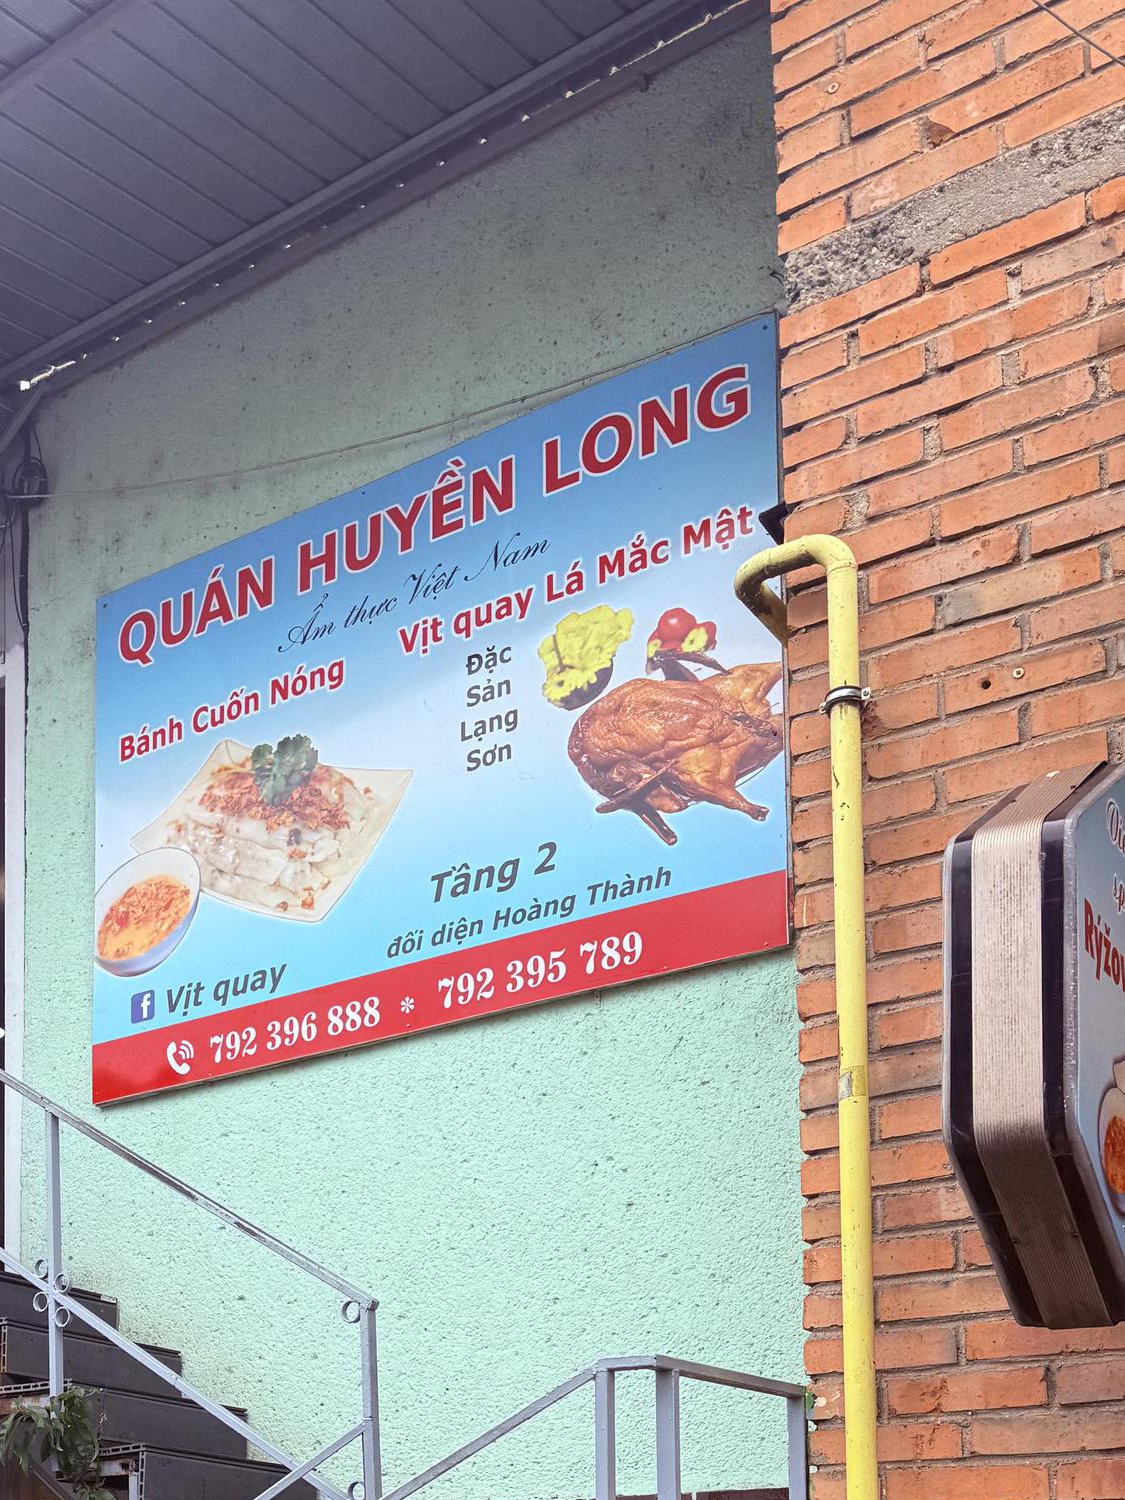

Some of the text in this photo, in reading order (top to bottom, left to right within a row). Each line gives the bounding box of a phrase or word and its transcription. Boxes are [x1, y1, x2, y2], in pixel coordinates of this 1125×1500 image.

[119, 364, 751, 665] QUÁN HUYỀN LONG
[278, 532, 550, 653] Ẩm thực Việt Nam
[398, 506, 753, 655] Vịt quay Lá Mắc Mật
[465, 645, 512, 676] Đặc
[466, 678, 512, 707] Sản
[119, 660, 344, 762] Bánh Cuốn Nóng
[460, 709, 518, 742] Lạng
[466, 743, 512, 772] Sơn
[430, 841, 557, 902] Tầng 2
[386, 866, 672, 958] đối diện Hoàng Thành
[165, 981, 204, 1017] Vịt
[212, 963, 287, 1007] quay
[209, 931, 643, 1064] 792 396 888 792 395 789
